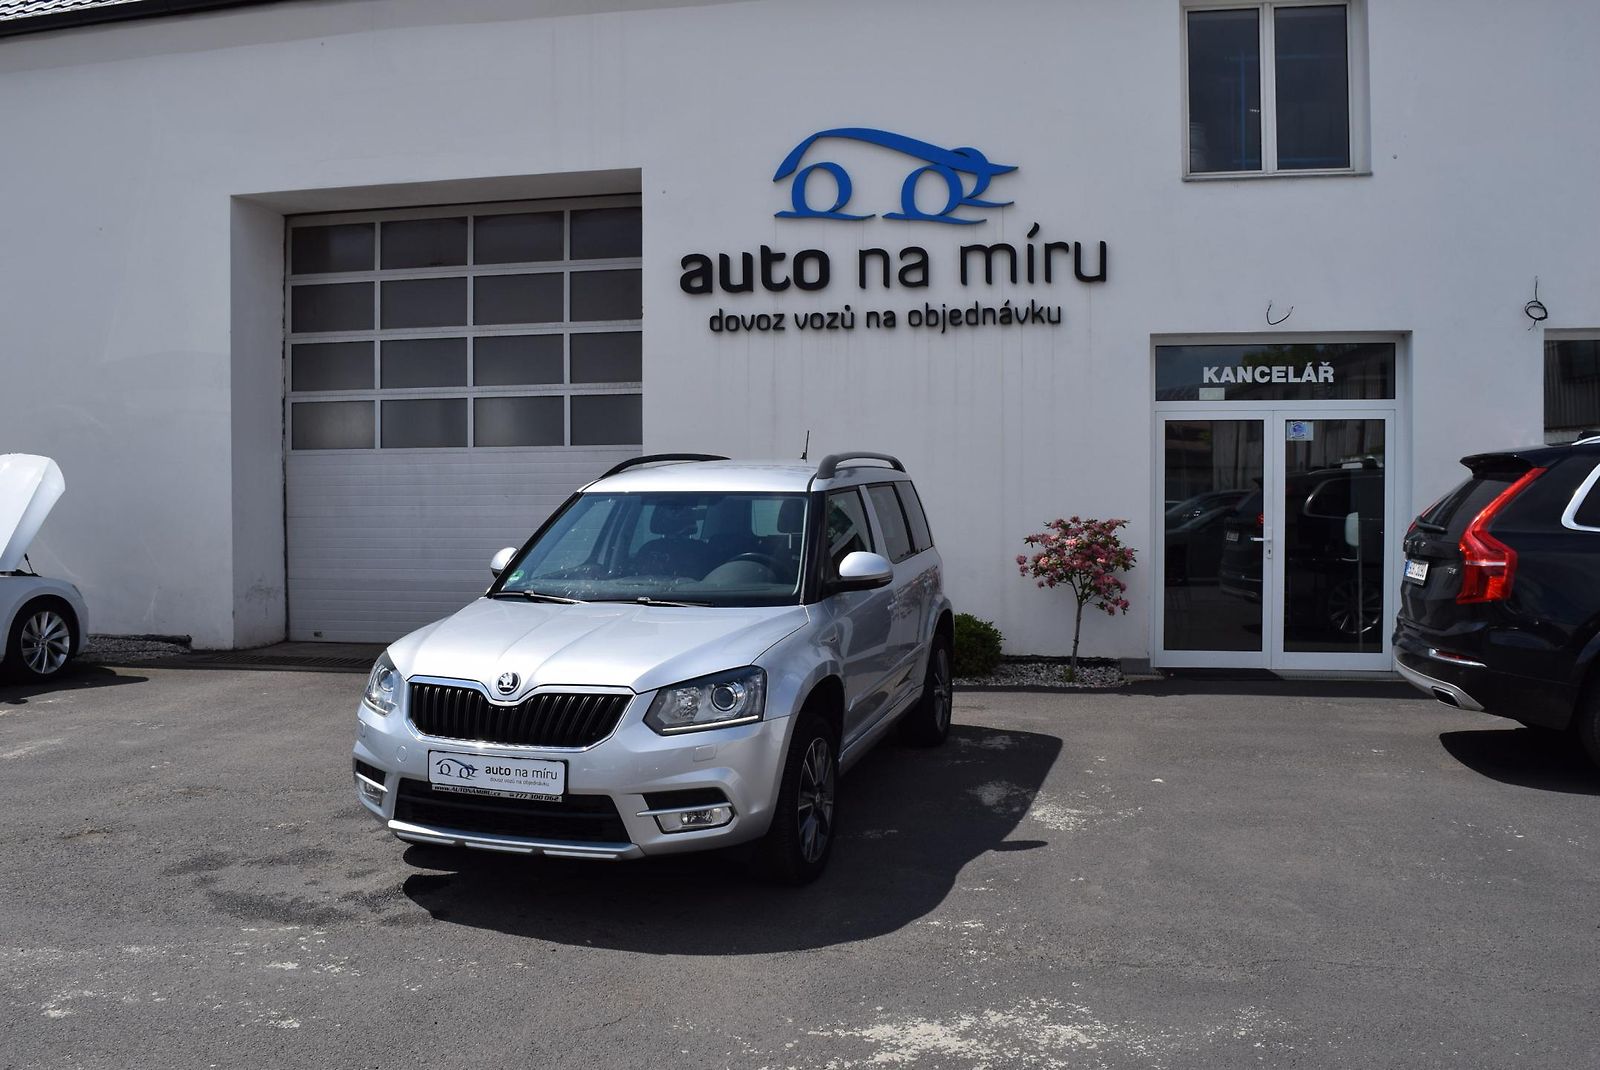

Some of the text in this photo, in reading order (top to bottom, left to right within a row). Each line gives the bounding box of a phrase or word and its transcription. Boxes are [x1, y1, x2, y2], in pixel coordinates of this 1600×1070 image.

[680, 222, 1107, 294] auto na míru
[709, 300, 1061, 333] dovoz vozů na objednávku
[1203, 362, 1335, 383] KANCELÁŘ
[485, 765, 557, 780] auto na míru
